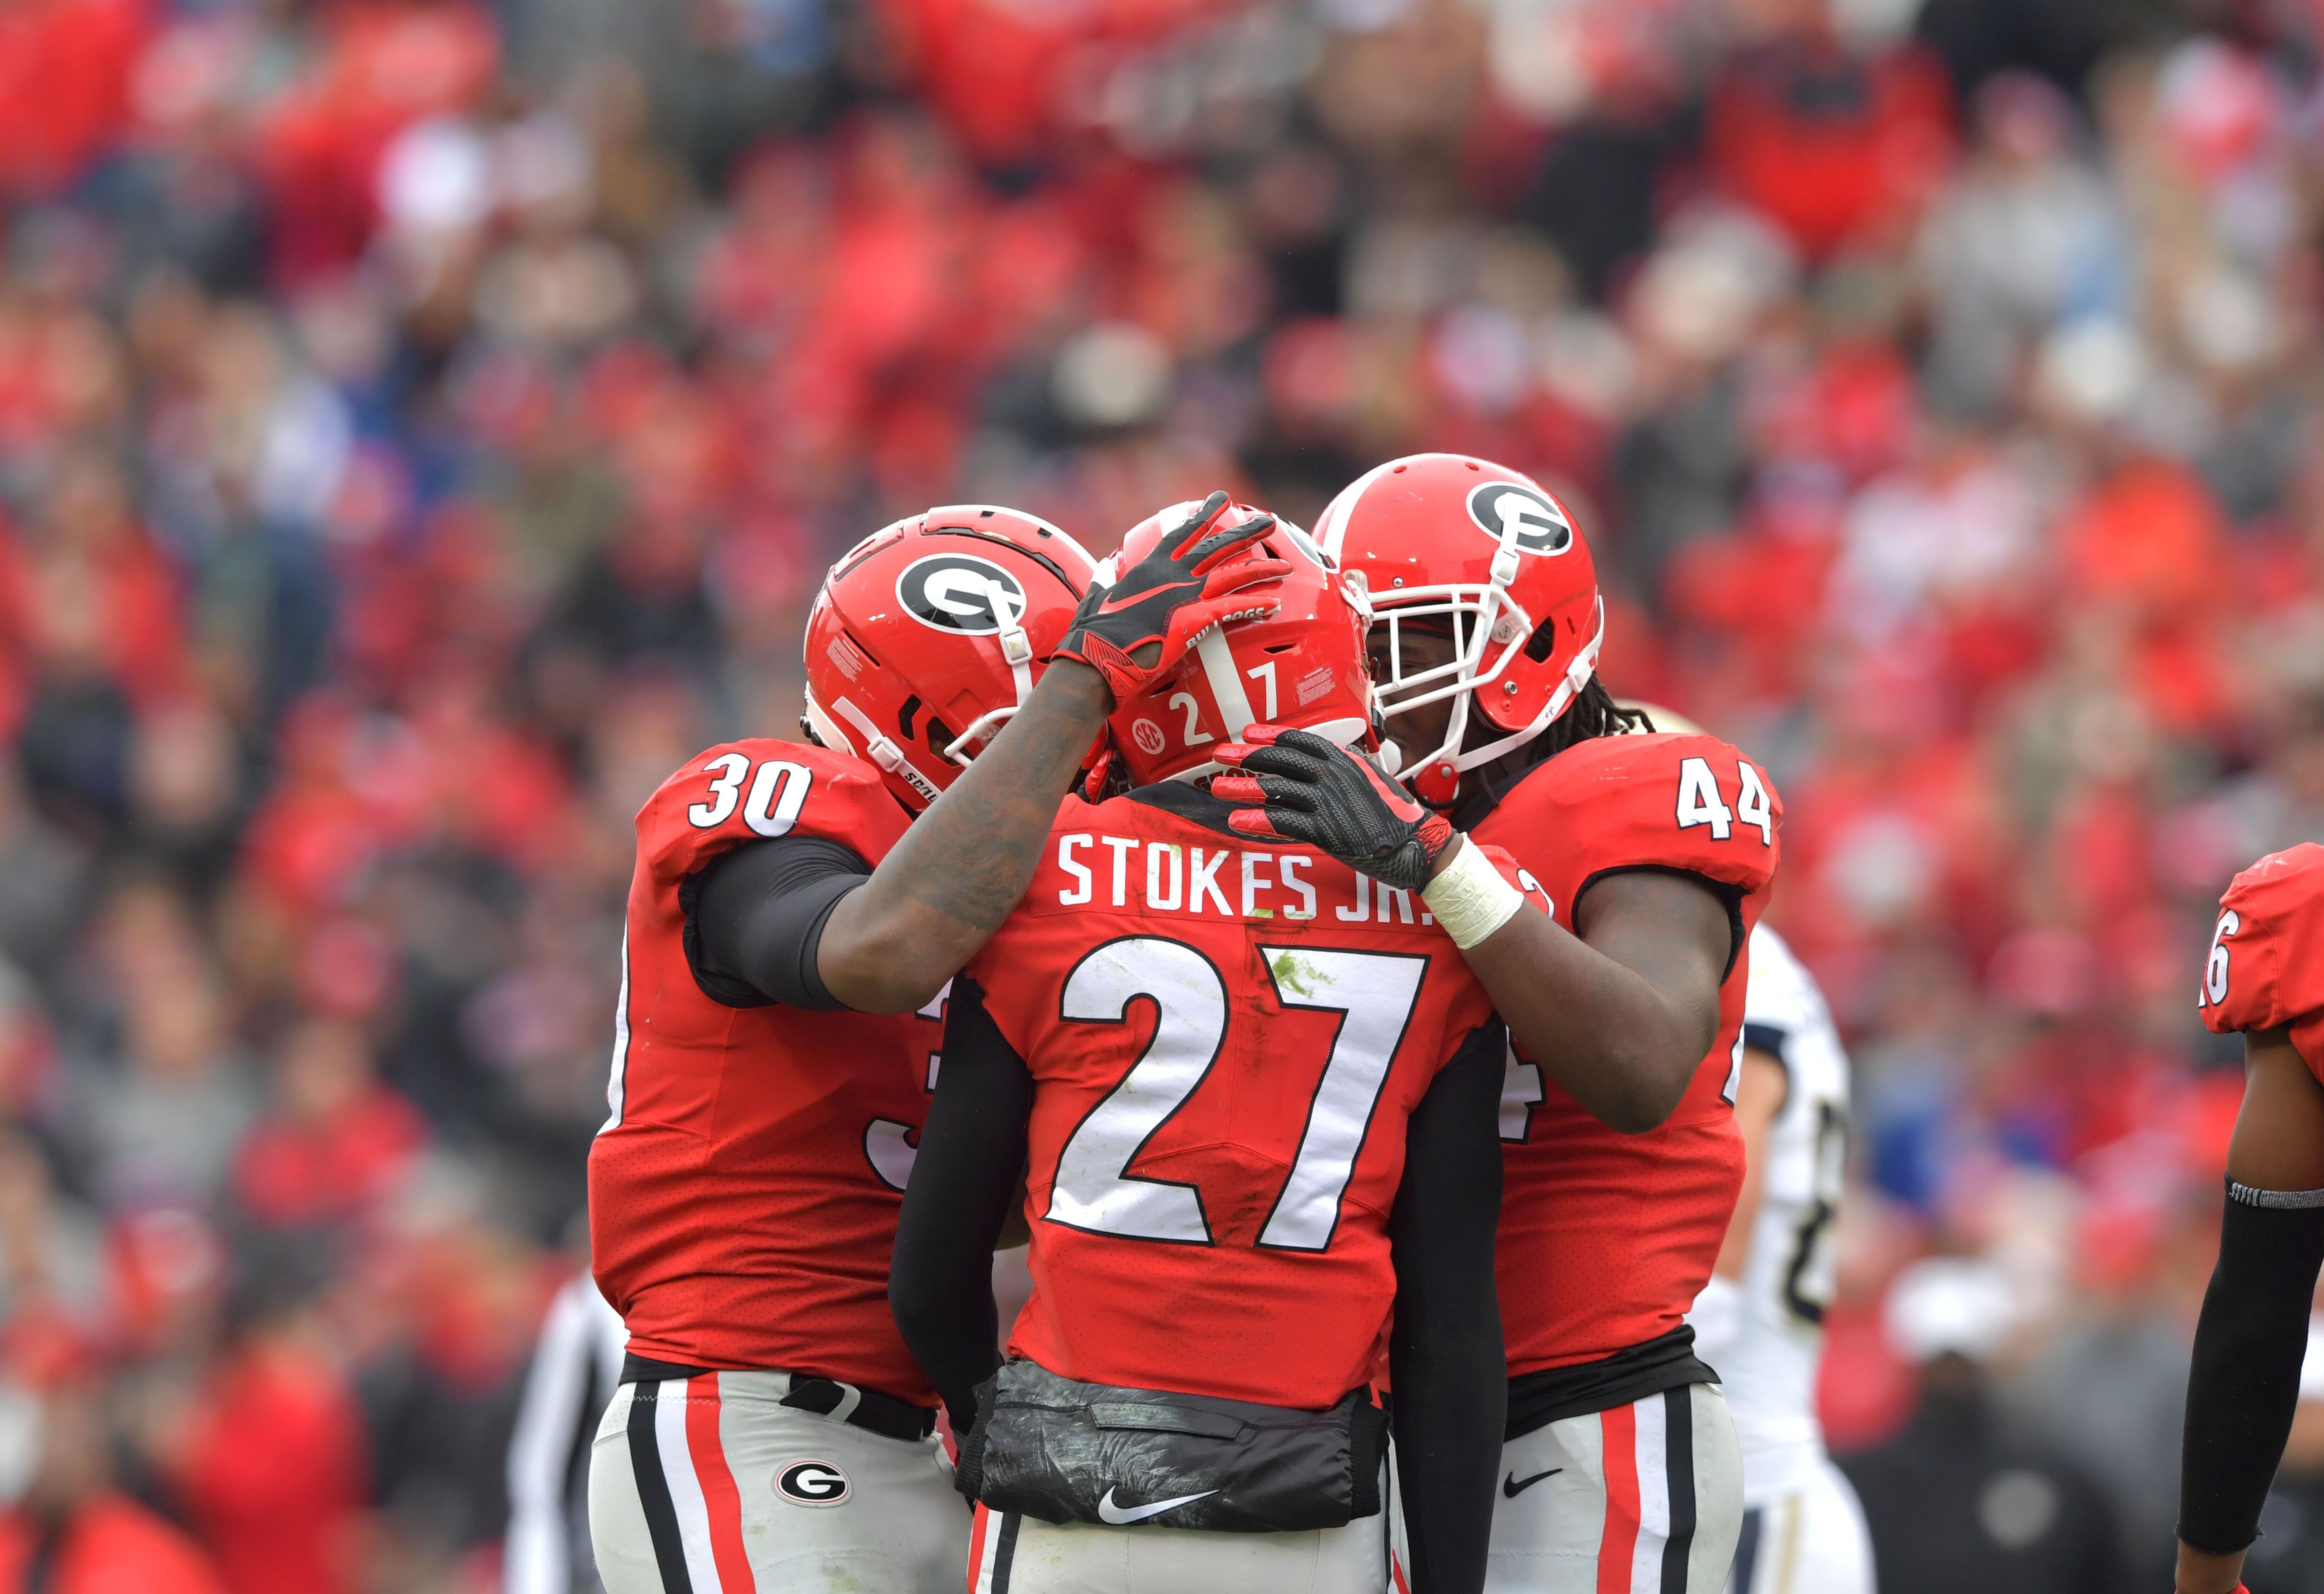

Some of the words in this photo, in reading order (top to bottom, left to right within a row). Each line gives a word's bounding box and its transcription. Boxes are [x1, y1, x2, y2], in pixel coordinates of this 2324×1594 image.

[1135, 722, 1161, 750] SEC
[688, 752, 813, 837] 30
[1675, 756, 1772, 848] 44
[1058, 833, 1317, 920] STOKES
[2198, 908, 2240, 1009] 6
[1040, 934, 1432, 1253] 27
[779, 1461, 847, 1502] G
